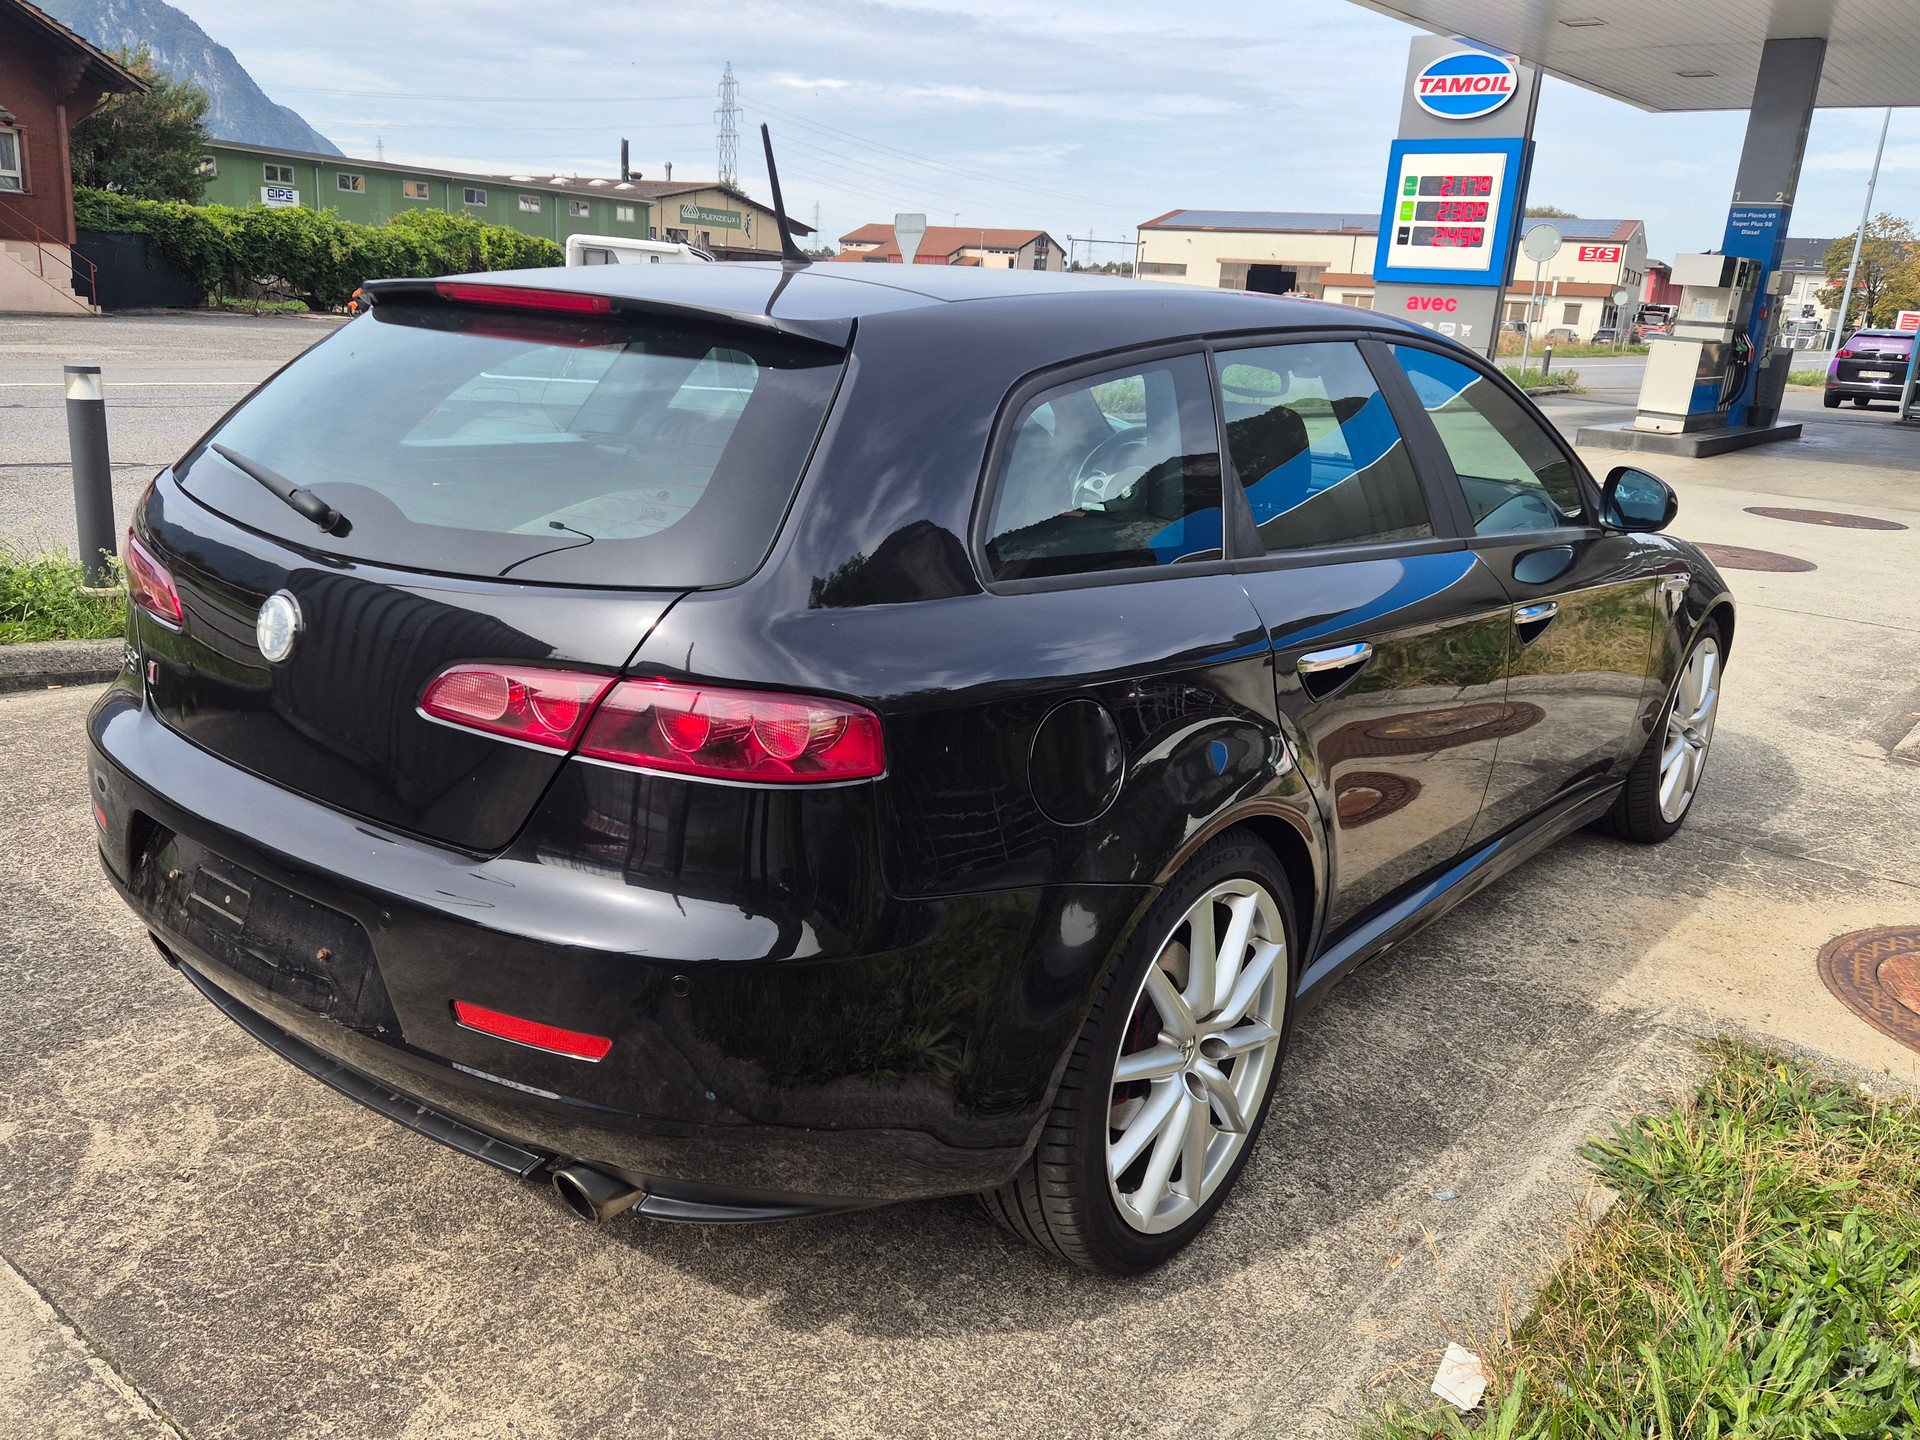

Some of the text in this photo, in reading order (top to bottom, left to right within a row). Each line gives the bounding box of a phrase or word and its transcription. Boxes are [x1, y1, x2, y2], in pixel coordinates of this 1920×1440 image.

[1419, 76, 1511, 93] TAMOIL
[267, 188, 294, 200] GIPE
[1735, 191, 1784, 202] 1 2
[1732, 220, 1750, 228] Super
[1406, 295, 1458, 312] avec
